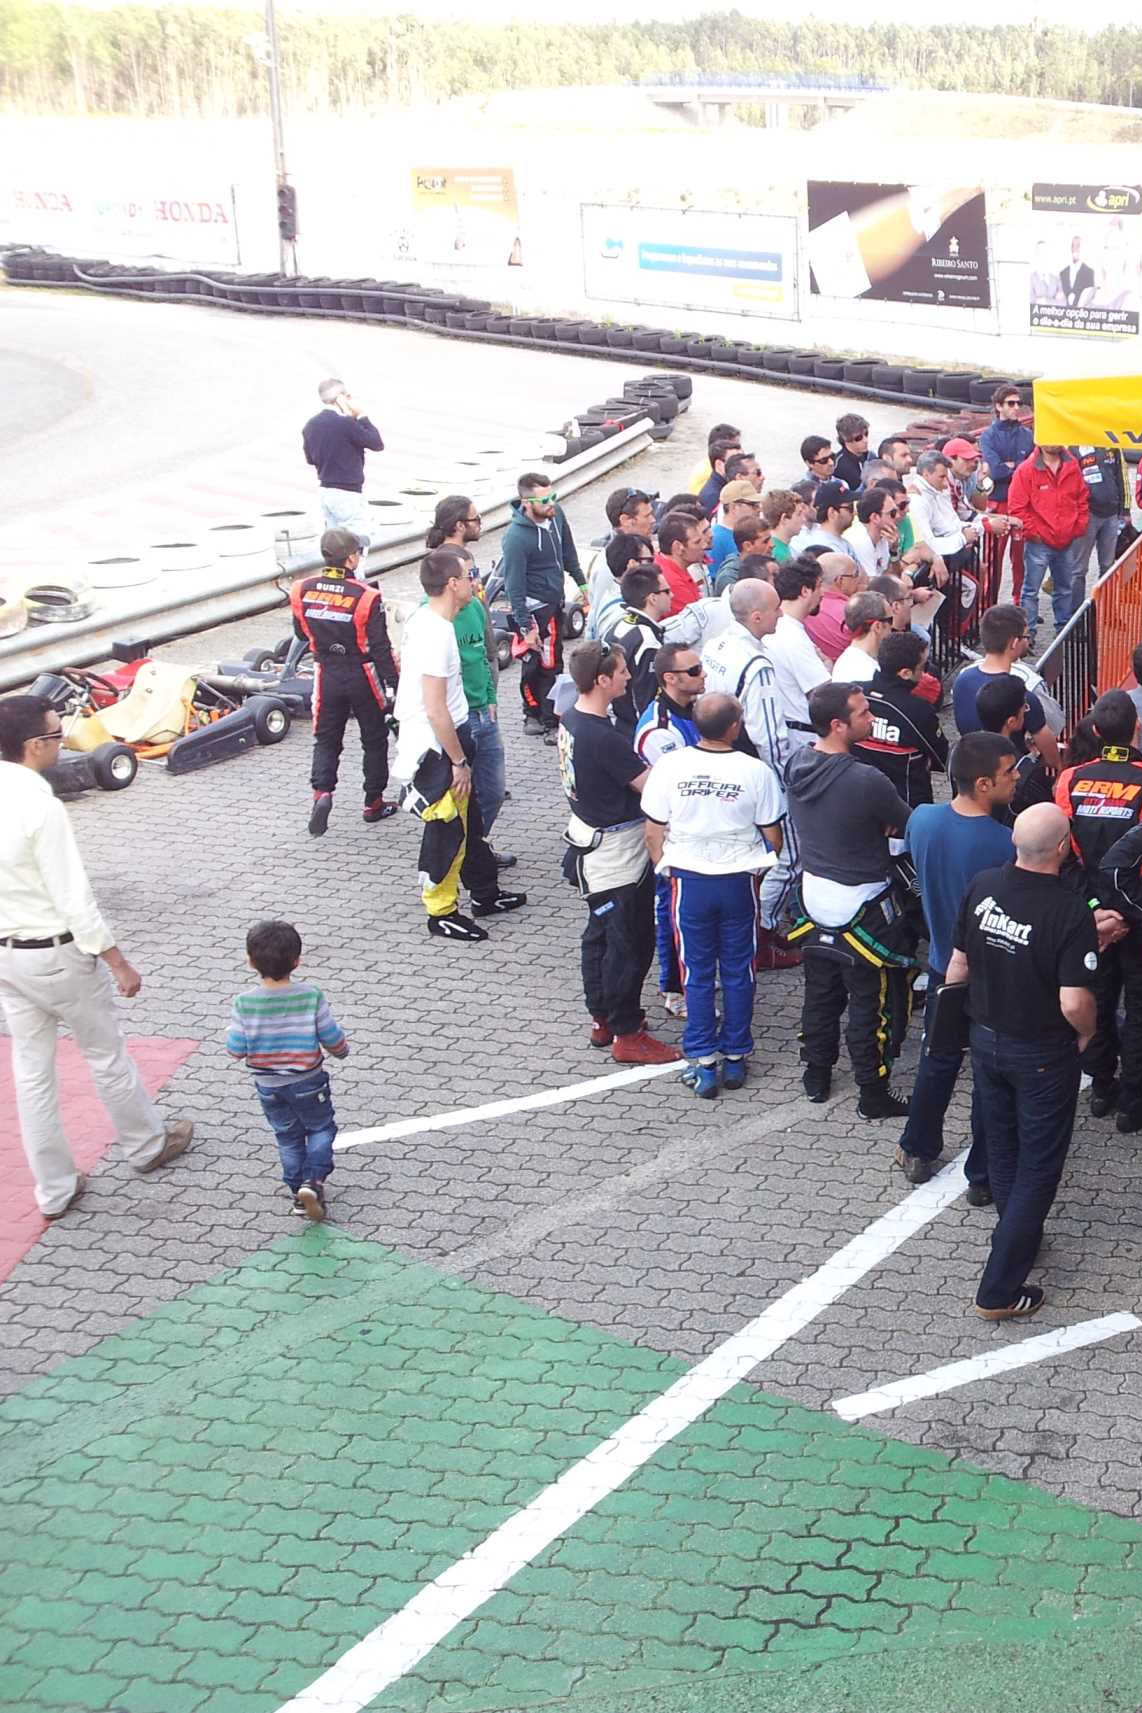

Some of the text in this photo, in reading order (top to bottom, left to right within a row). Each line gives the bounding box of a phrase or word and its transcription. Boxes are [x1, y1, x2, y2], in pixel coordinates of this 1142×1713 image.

[154, 199, 229, 224] HONDA
[957, 259, 979, 270] SANTO
[1032, 305, 1128, 322] A melhor opção para gerir
[1085, 322, 1100, 330] sua
[1101, 323, 1137, 334] empresa
[677, 781, 745, 792] OFFICIAL
[1072, 779, 1142, 801] BRM
[680, 788, 739, 800] DRIVER
